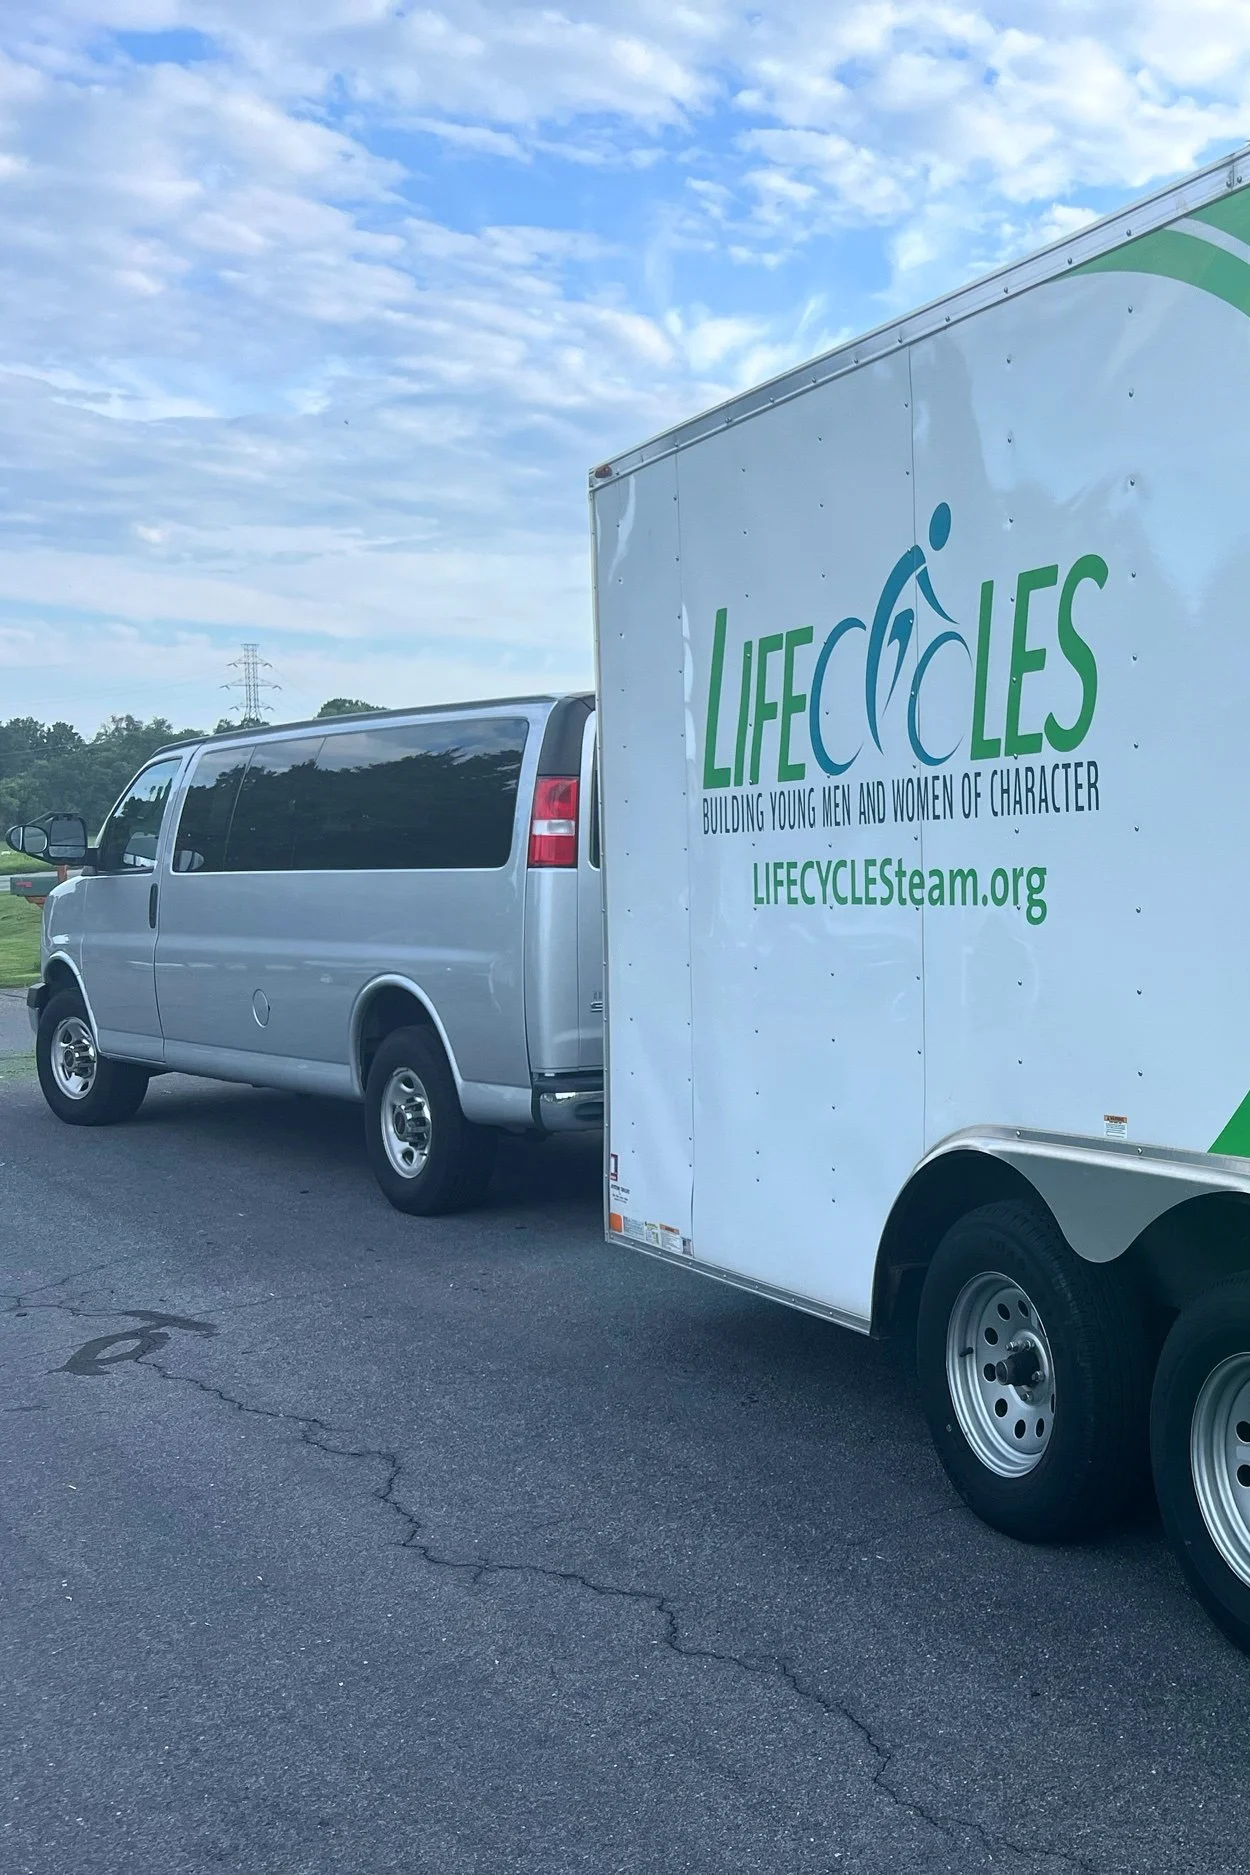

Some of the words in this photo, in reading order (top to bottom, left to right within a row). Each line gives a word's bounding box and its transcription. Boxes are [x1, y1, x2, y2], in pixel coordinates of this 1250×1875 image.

[702, 794, 764, 835] BUILDING
[769, 788, 815, 832] YOUNG
[822, 783, 851, 828] MEN
[858, 780, 886, 825] AND
[892, 774, 954, 823] WOMEN
[961, 771, 982, 818] OF
[990, 760, 1100, 818] CHARACTER
[753, 857, 1047, 926] LIFECYCLESteam.org
